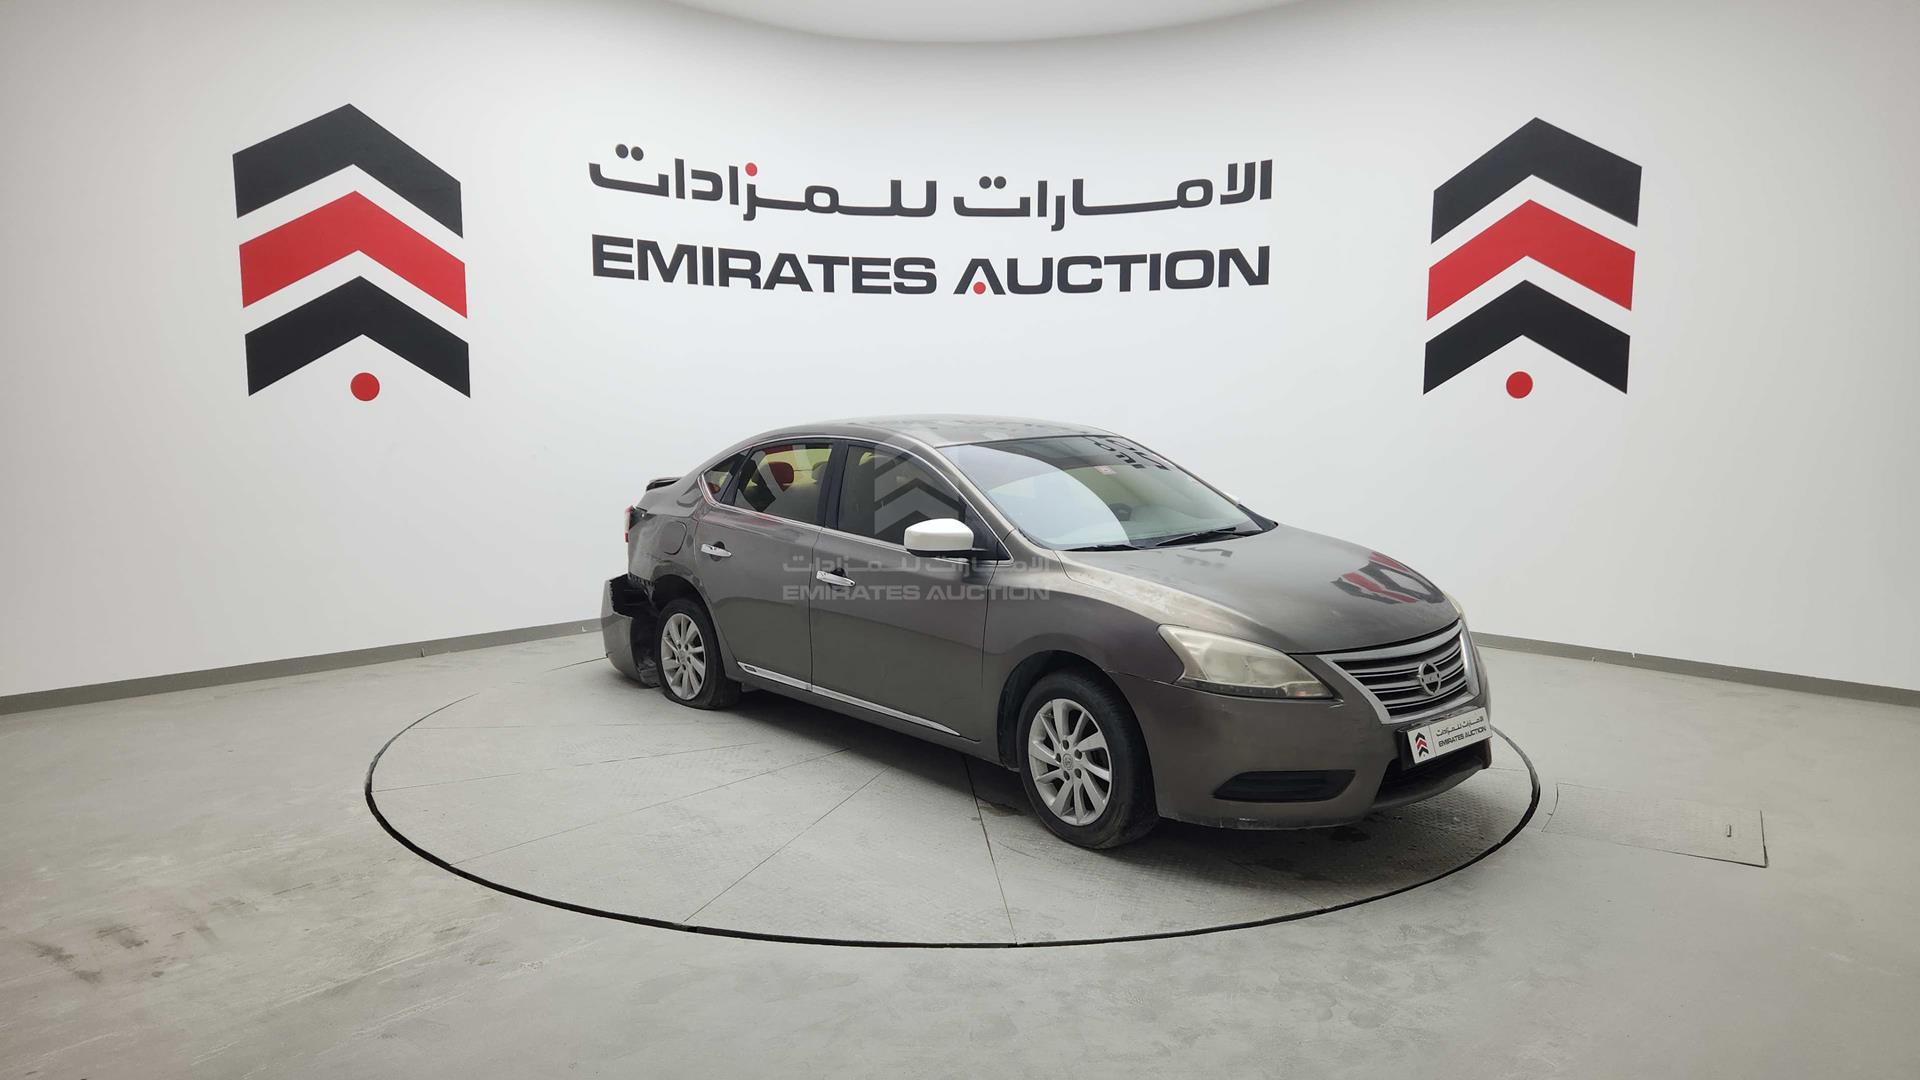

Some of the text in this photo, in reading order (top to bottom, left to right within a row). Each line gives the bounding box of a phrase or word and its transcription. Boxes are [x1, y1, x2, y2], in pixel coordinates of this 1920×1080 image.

[588, 143, 1273, 232] الامارات للمزادات
[592, 234, 1270, 295] EMIRATES AUCTION
[1438, 726, 1486, 747] EMIRATES AUCTION
